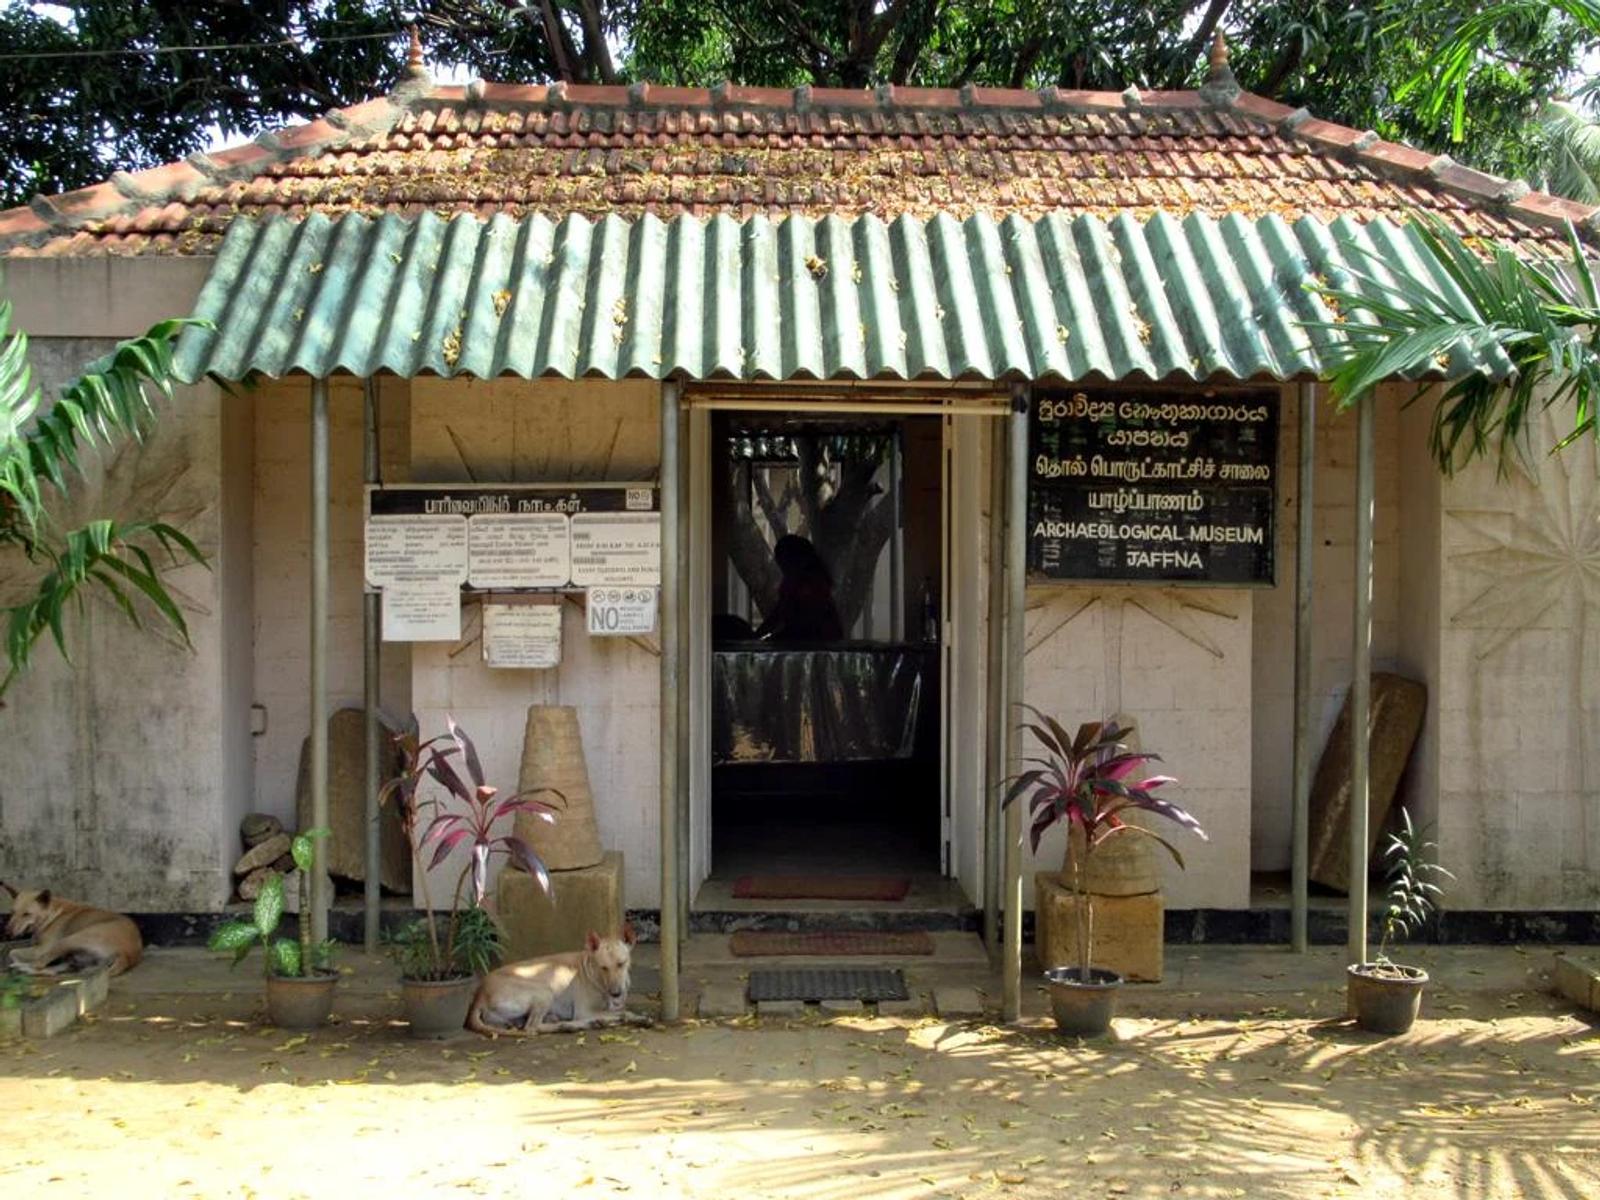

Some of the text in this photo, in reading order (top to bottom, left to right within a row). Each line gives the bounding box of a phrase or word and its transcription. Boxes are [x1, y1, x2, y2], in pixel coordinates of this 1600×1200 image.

[1036, 455, 1270, 482] தொல் பொருட்காட்சிச் சாலை
[1089, 488, 1203, 513] யாழ்ப்பாணம்
[1033, 522, 1264, 544] ARCHAEOLOGICAL MUSEUM
[1127, 551, 1203, 568] JAFFNA
[591, 606, 619, 630] NO
